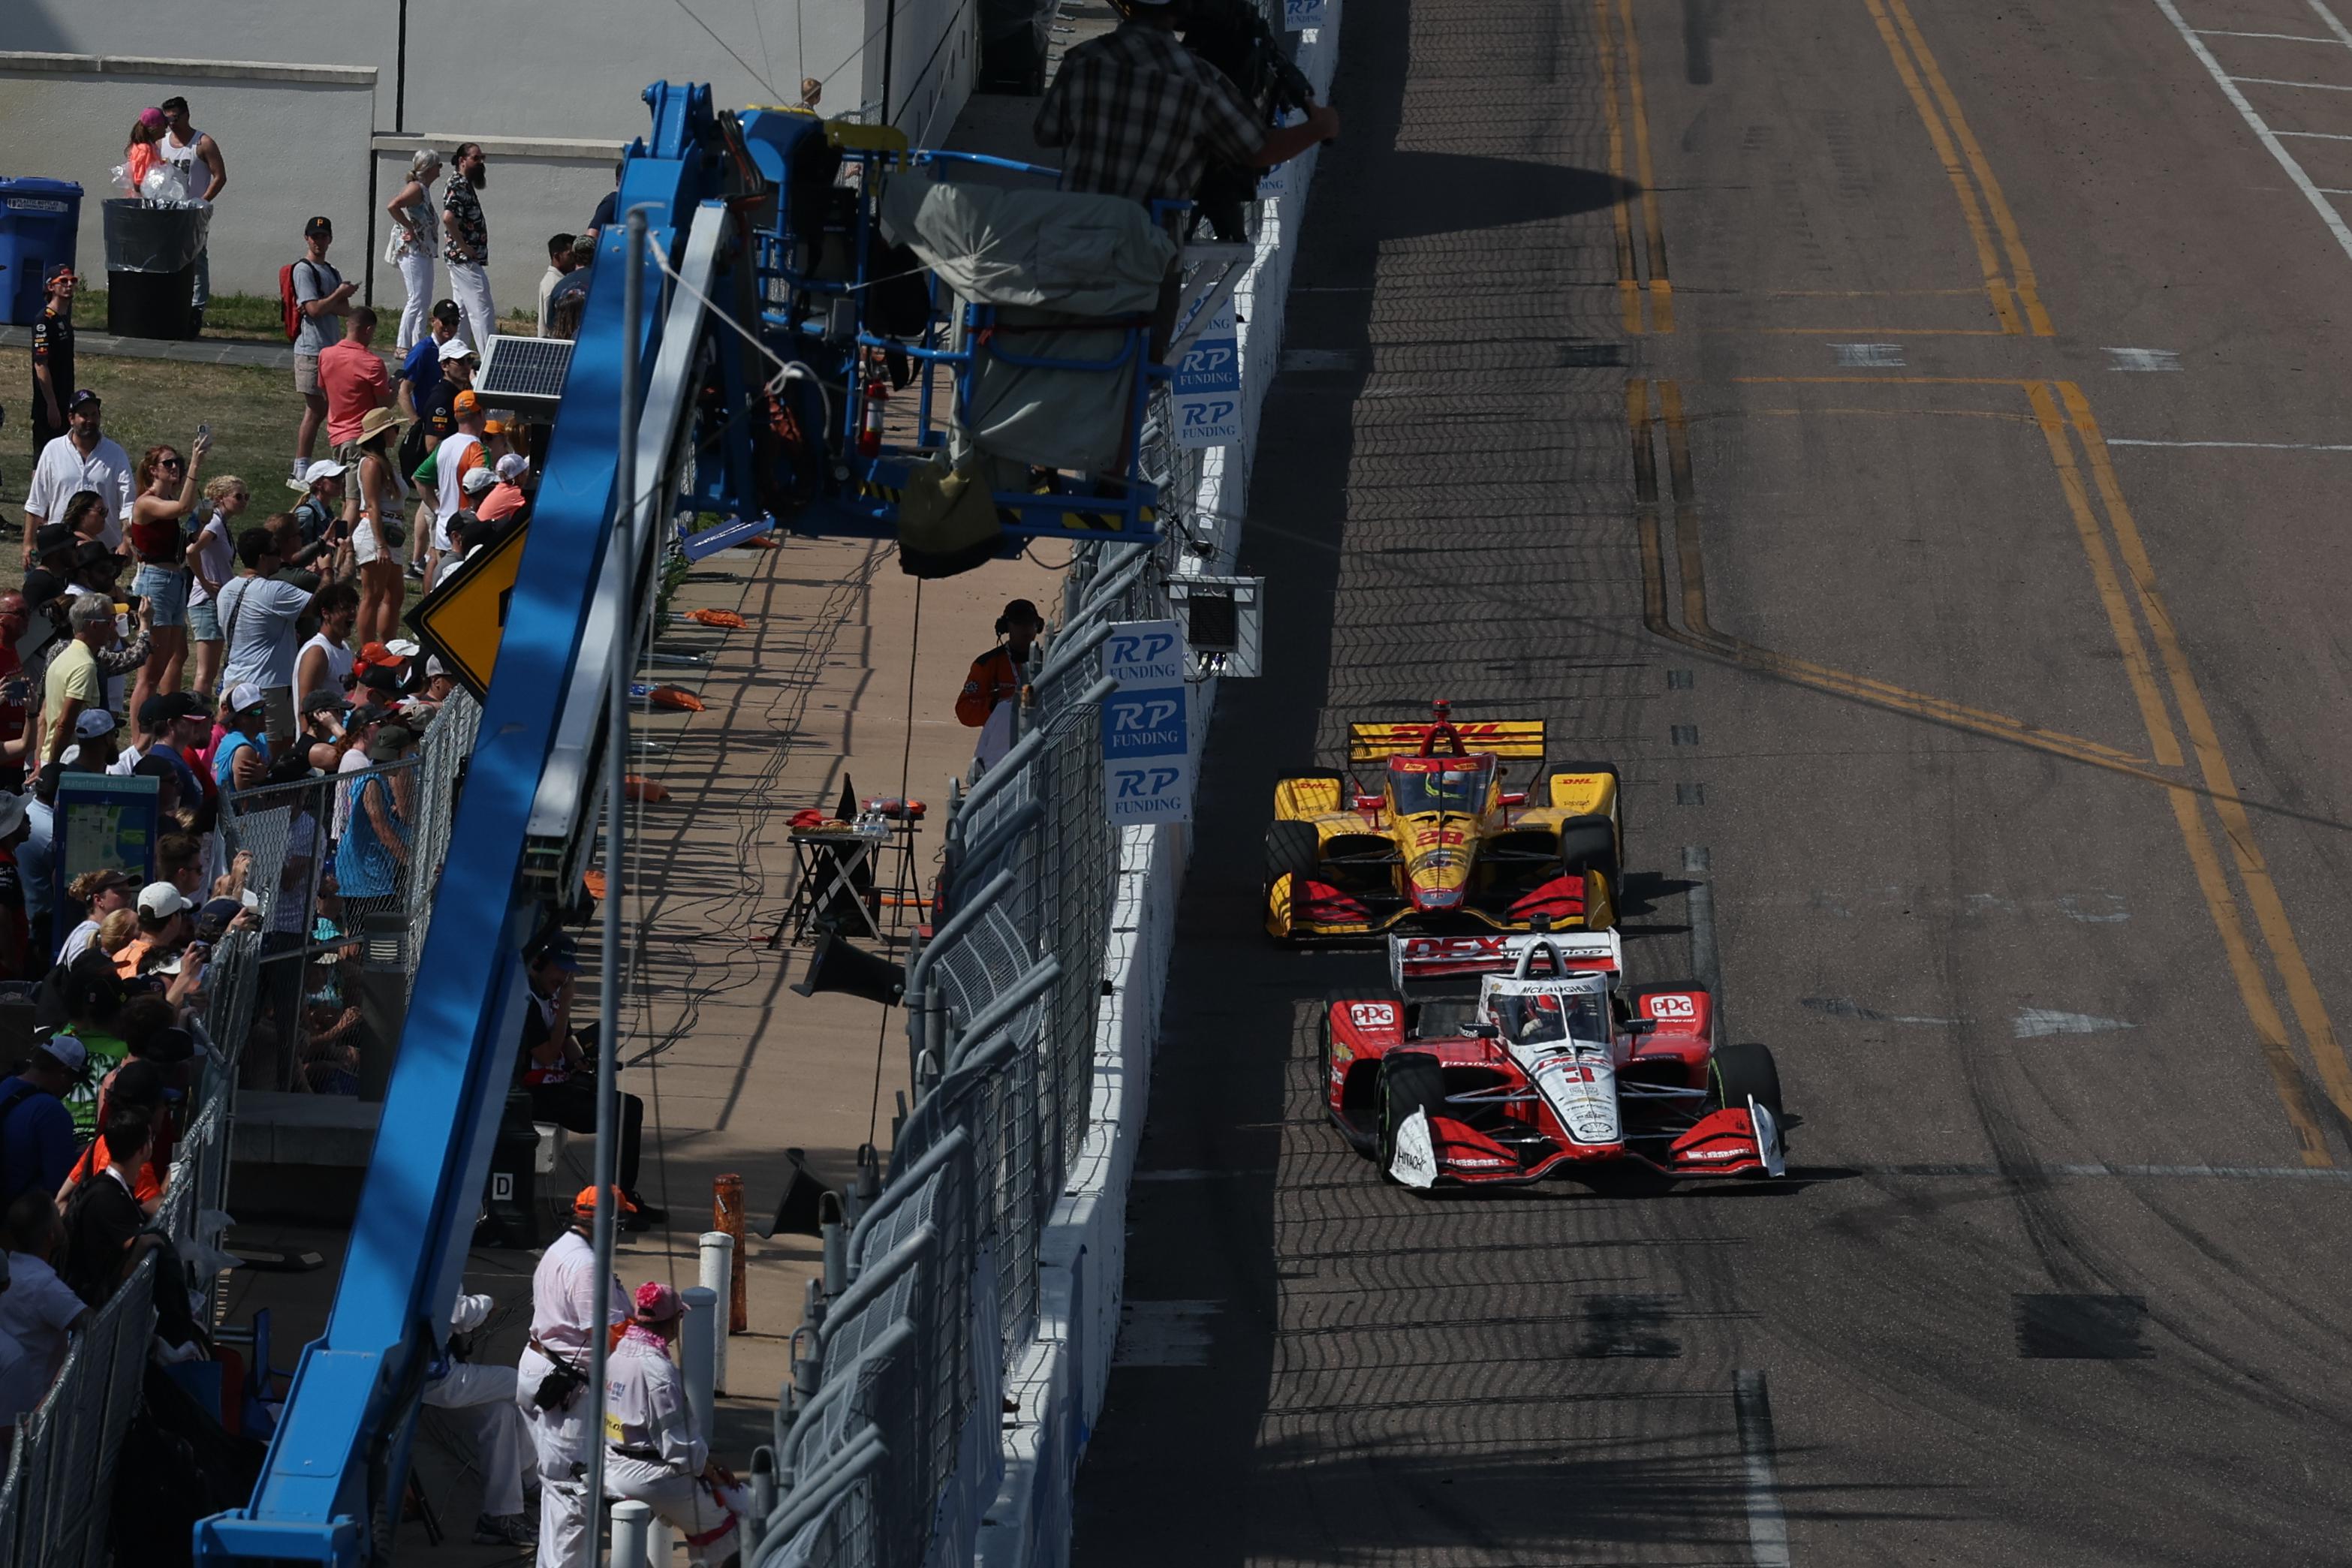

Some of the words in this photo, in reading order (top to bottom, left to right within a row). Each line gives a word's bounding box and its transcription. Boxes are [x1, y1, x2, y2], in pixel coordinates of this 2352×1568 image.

[317, 218, 323, 227] P
[1177, 318, 1230, 332] FING
[1182, 348, 1230, 372] RP
[1180, 372, 1233, 385] FUNDING
[1182, 401, 1233, 426] RP
[1182, 426, 1236, 439] FUNDING
[1109, 634, 1173, 664] RP
[1110, 664, 1176, 679] FUNDING
[1112, 700, 1176, 730] RP
[1113, 730, 1178, 747] FUNDING
[64, 780, 104, 788] Waterfront
[125, 781, 152, 790] District
[1115, 768, 1179, 797] RP
[1116, 797, 1181, 814] FUNDING
[1416, 830, 1465, 847] 28
[1405, 936, 1510, 959] DEX
[1353, 1006, 1392, 1023] PPG
[1653, 998, 1691, 1015] PPG
[1562, 1066, 1595, 1083] 3
[496, 1177, 510, 1196] D
